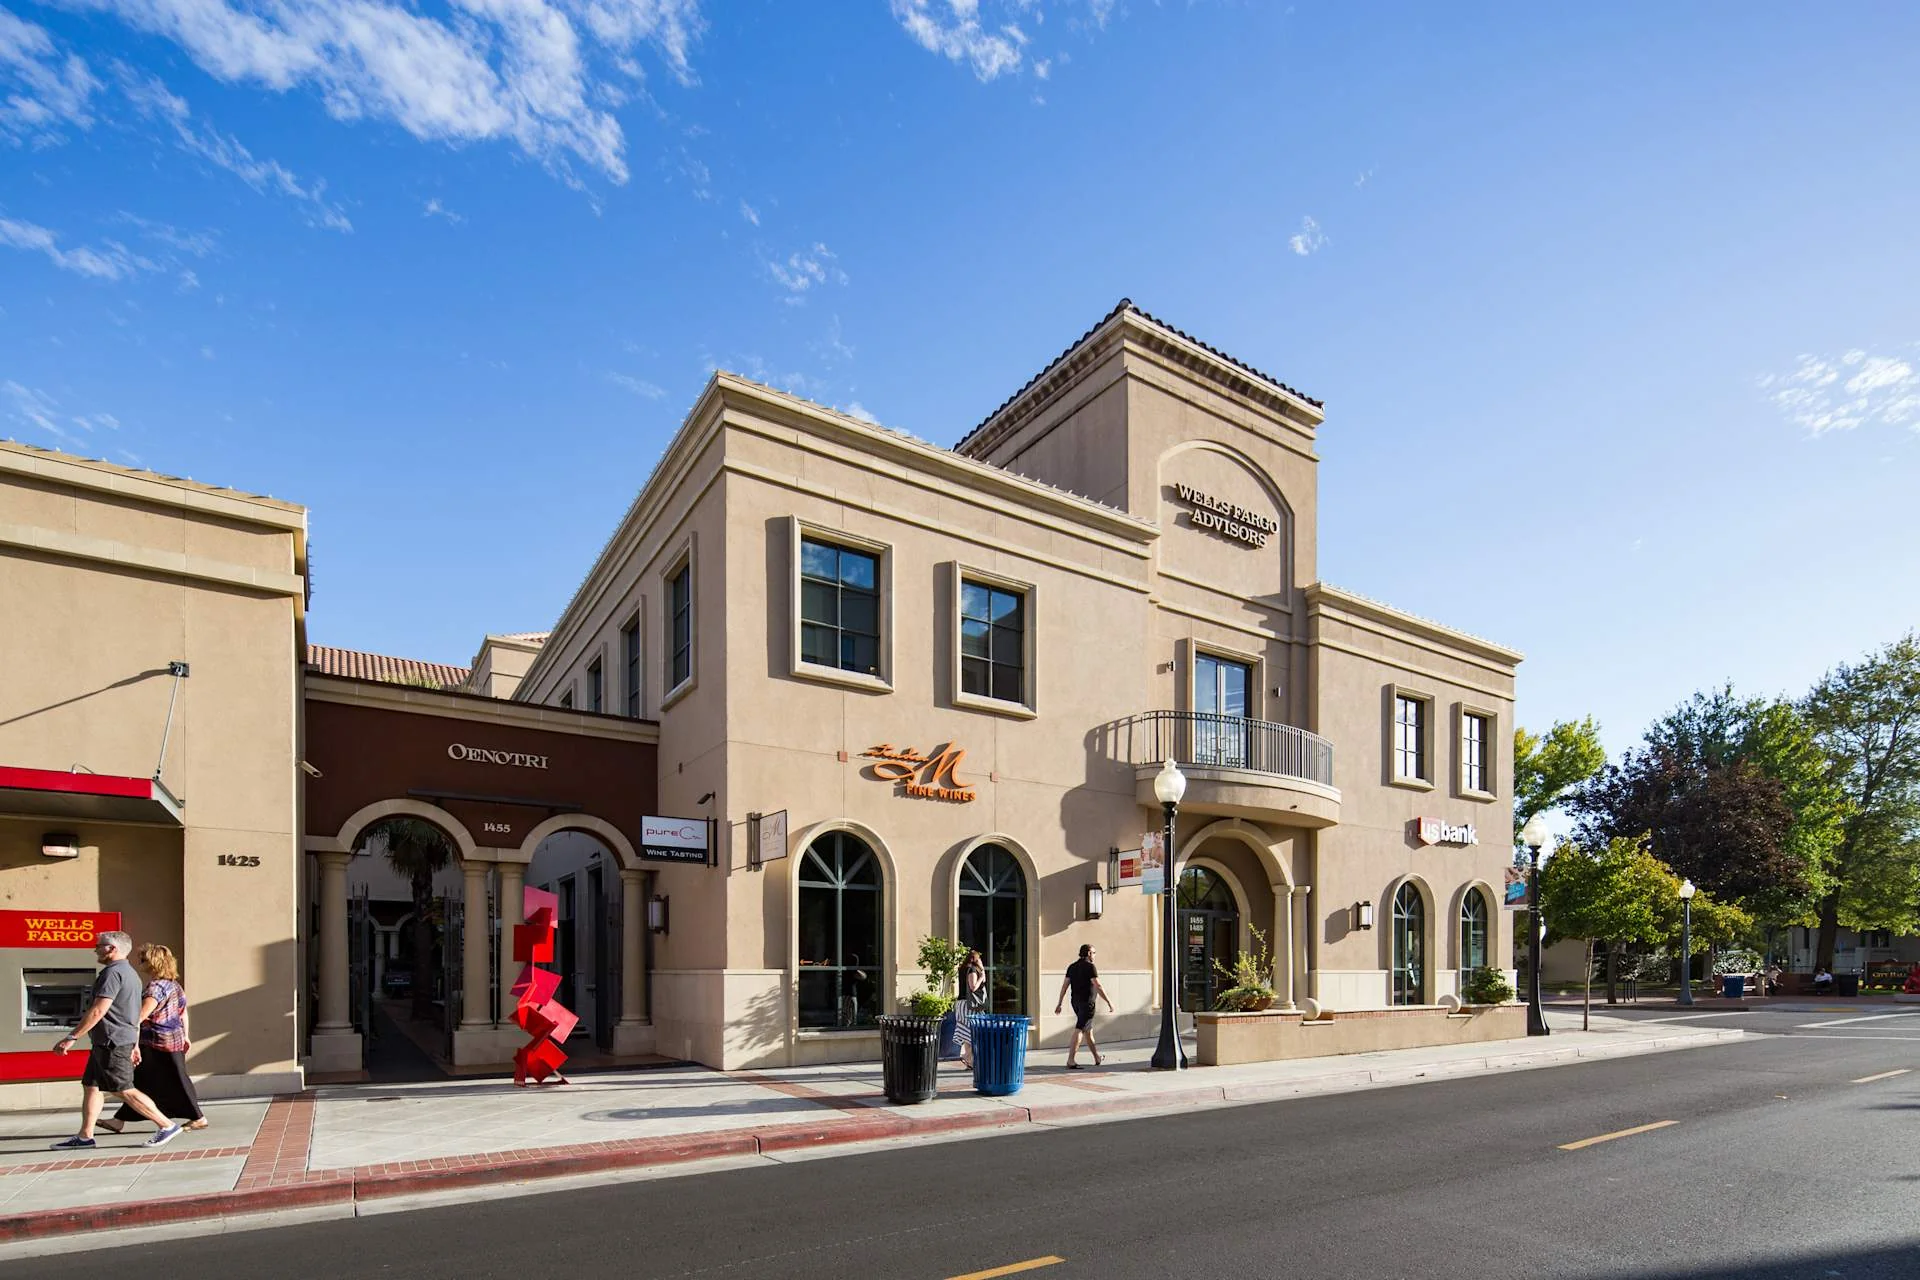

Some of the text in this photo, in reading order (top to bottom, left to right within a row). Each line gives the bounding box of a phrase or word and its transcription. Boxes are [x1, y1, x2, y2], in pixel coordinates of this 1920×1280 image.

[1175, 483, 1281, 535] WELLS FARGO
[1191, 508, 1269, 549] ADVISORS
[447, 743, 549, 769] OENOTRI
[906, 784, 976, 801] FINE WINES
[483, 822, 511, 833] 1455
[646, 848, 704, 859] WINE TASTING
[217, 854, 261, 867] 1425
[24, 918, 94, 930] WELLS
[26, 930, 94, 942] FARGO
